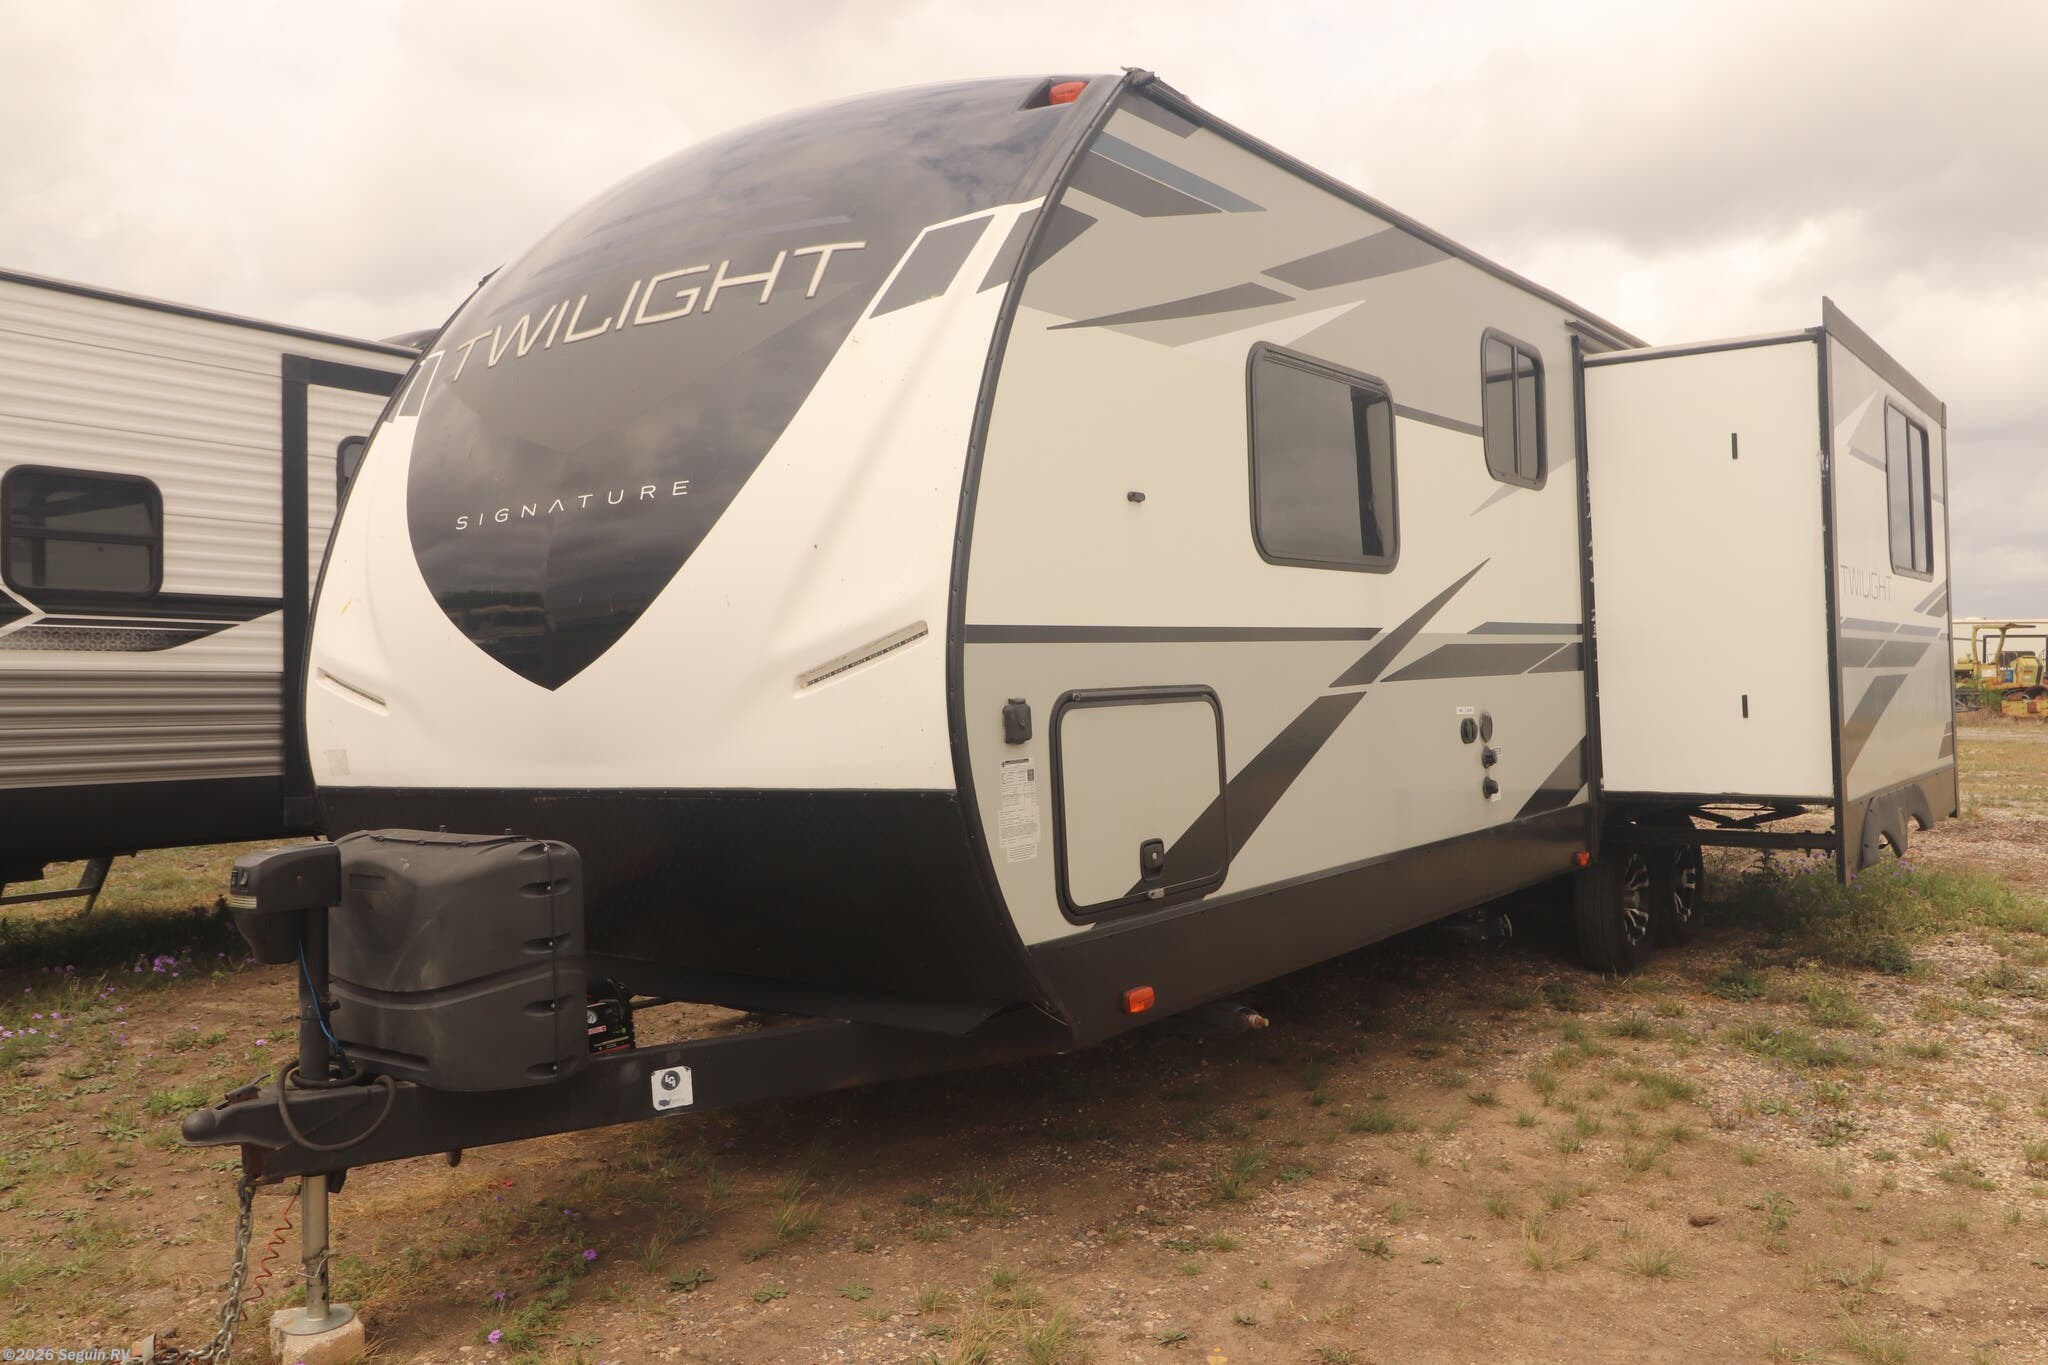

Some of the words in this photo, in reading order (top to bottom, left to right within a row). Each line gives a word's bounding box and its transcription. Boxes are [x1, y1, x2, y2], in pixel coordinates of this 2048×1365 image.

[451, 240, 867, 383] TWILIGHT
[455, 480, 692, 531] SIGNATURE
[1840, 564, 1892, 600] TWILIGHT
